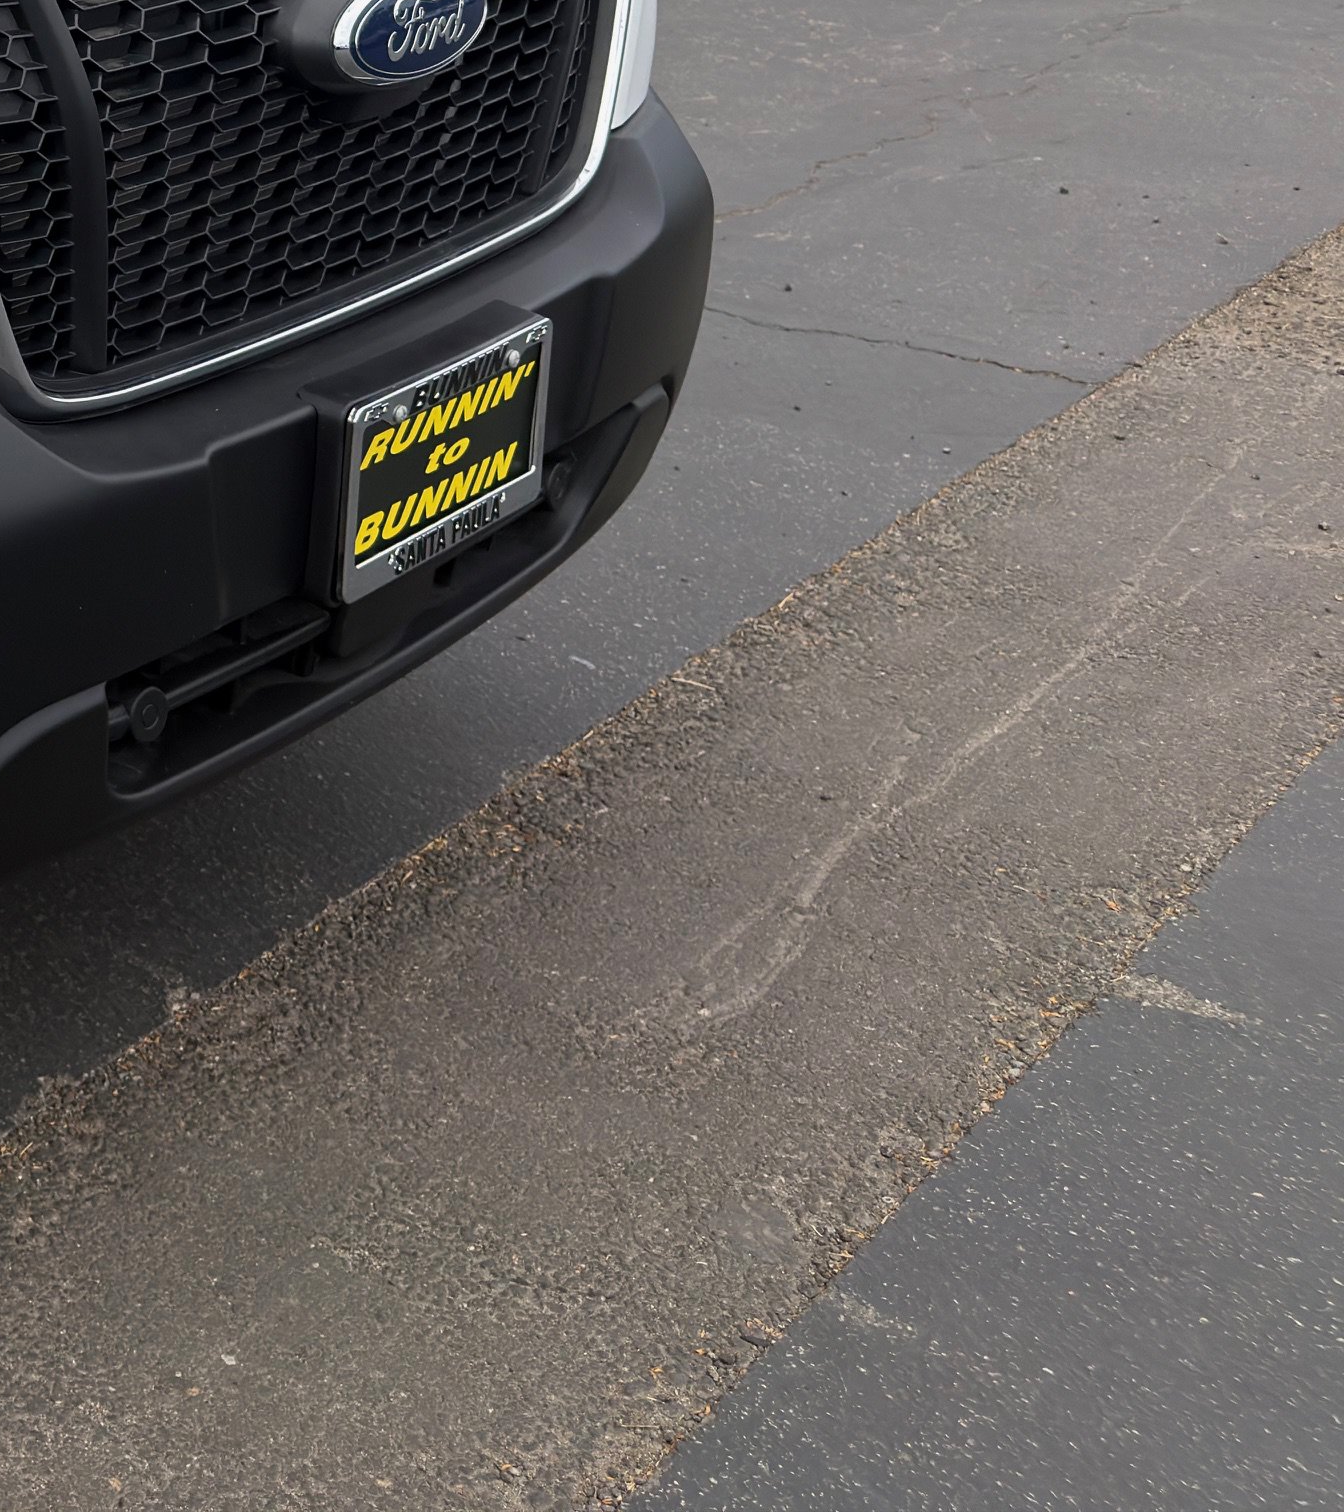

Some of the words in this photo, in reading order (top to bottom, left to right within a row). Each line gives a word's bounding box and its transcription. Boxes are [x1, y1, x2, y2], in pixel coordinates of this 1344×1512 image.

[412, 341, 510, 410] BUNNIN
[360, 360, 536, 471] RUNNIN'
[424, 437, 470, 474] to
[354, 441, 518, 556] BUNNIN
[452, 494, 500, 544] PAULA
